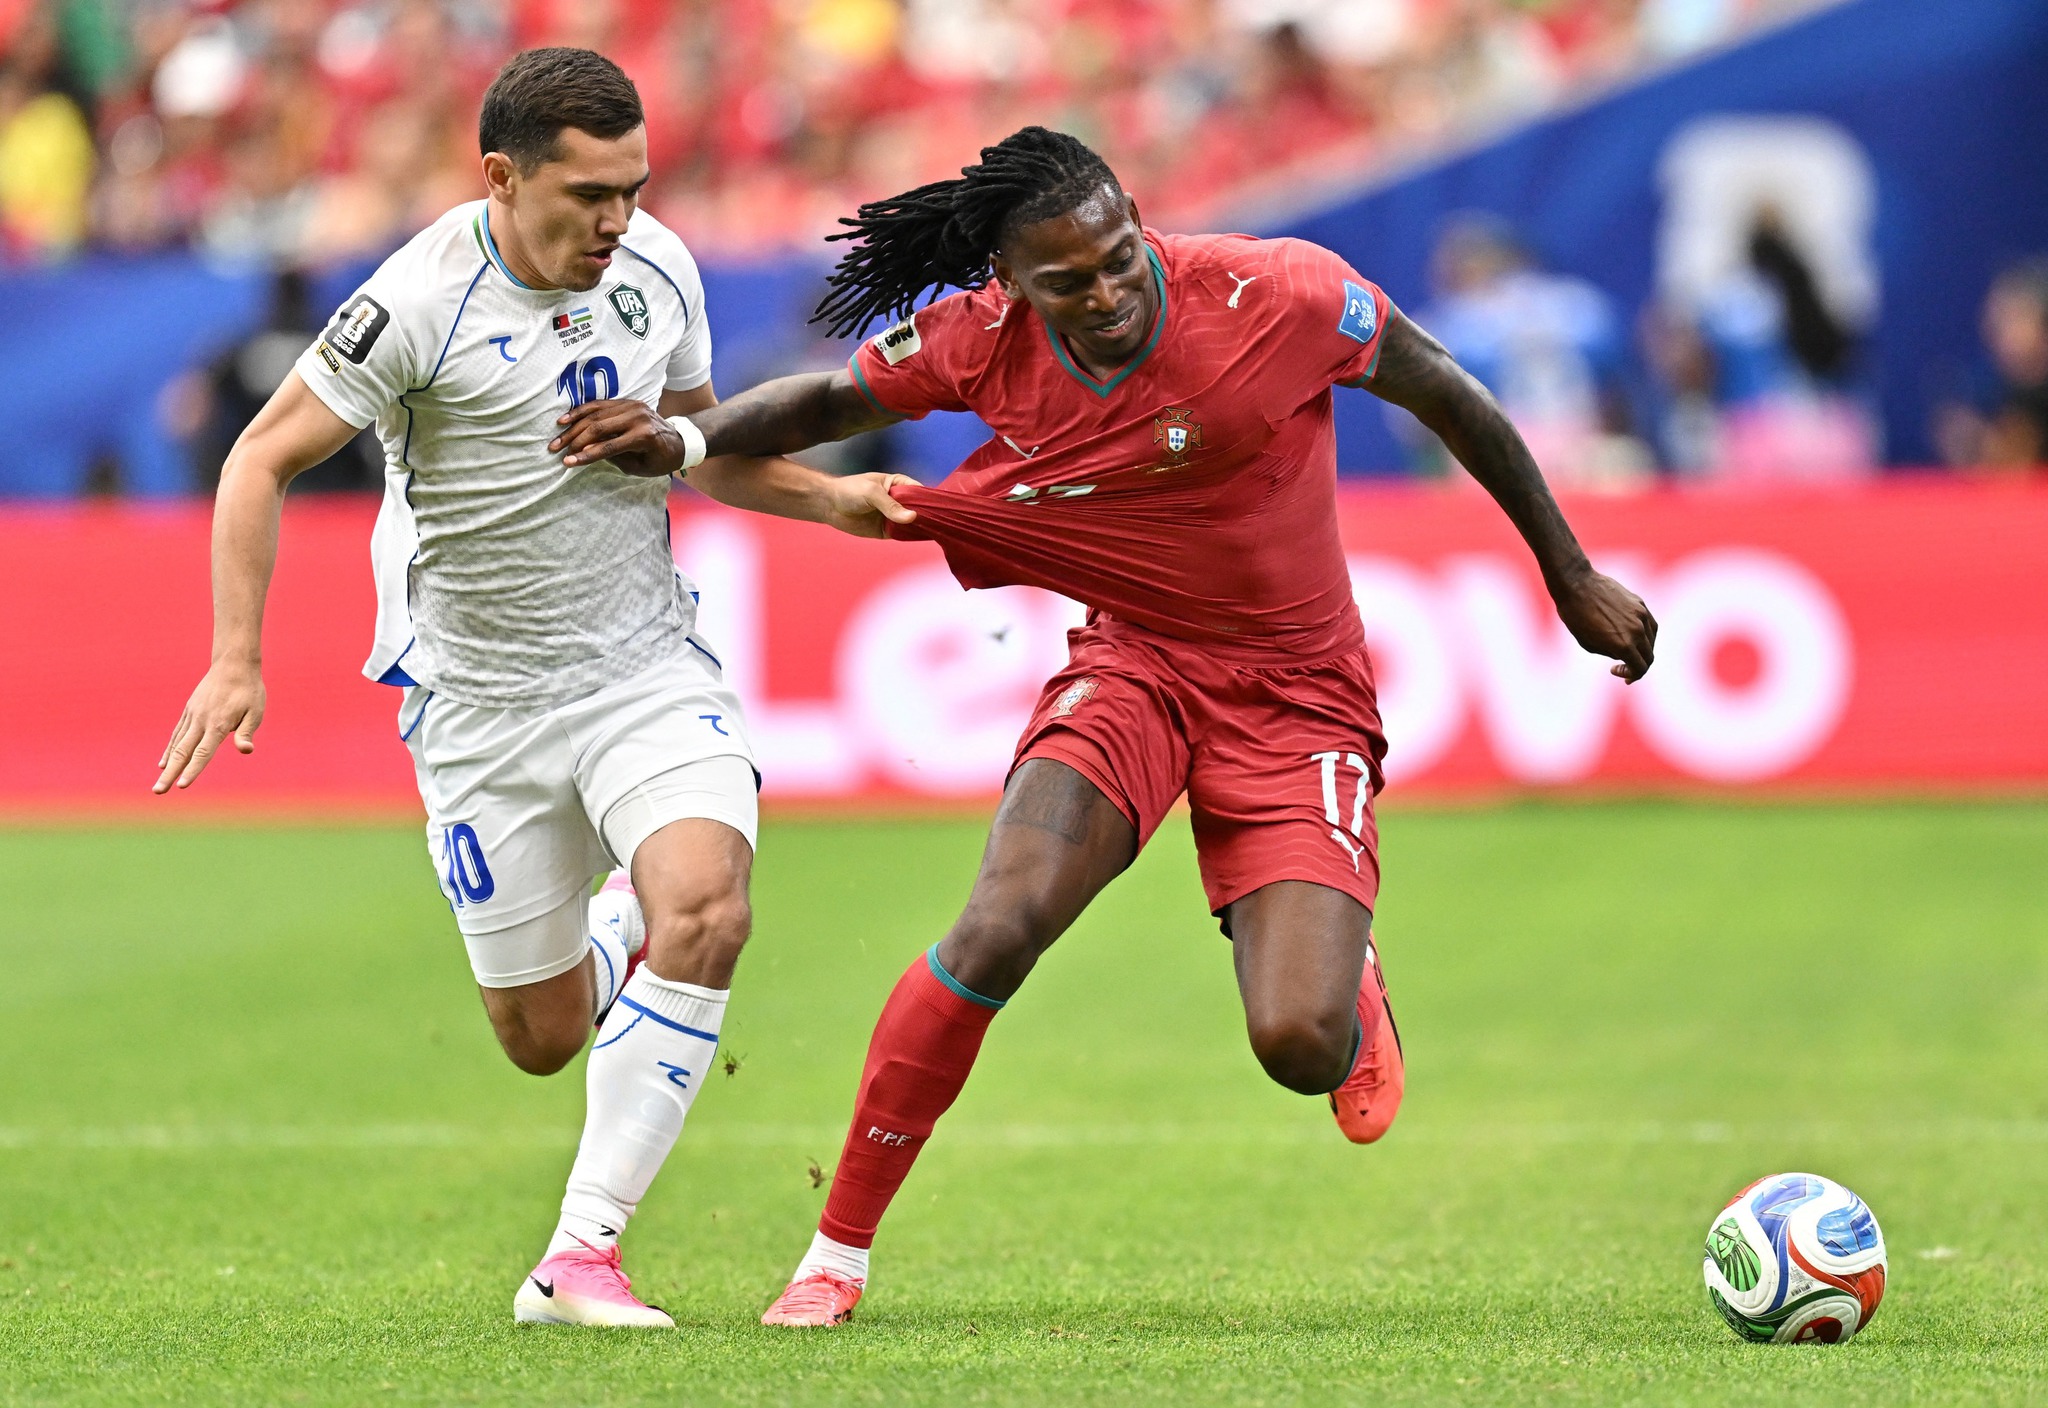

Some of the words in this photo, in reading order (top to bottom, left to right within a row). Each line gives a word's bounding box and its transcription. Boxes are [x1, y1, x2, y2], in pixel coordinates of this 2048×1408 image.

[580, 322, 592, 331] USA
[615, 293, 646, 313] UFA
[556, 355, 620, 411] 10
[686, 512, 1856, 792] Levo
[1310, 751, 1370, 839] 17
[441, 823, 495, 908] 10
